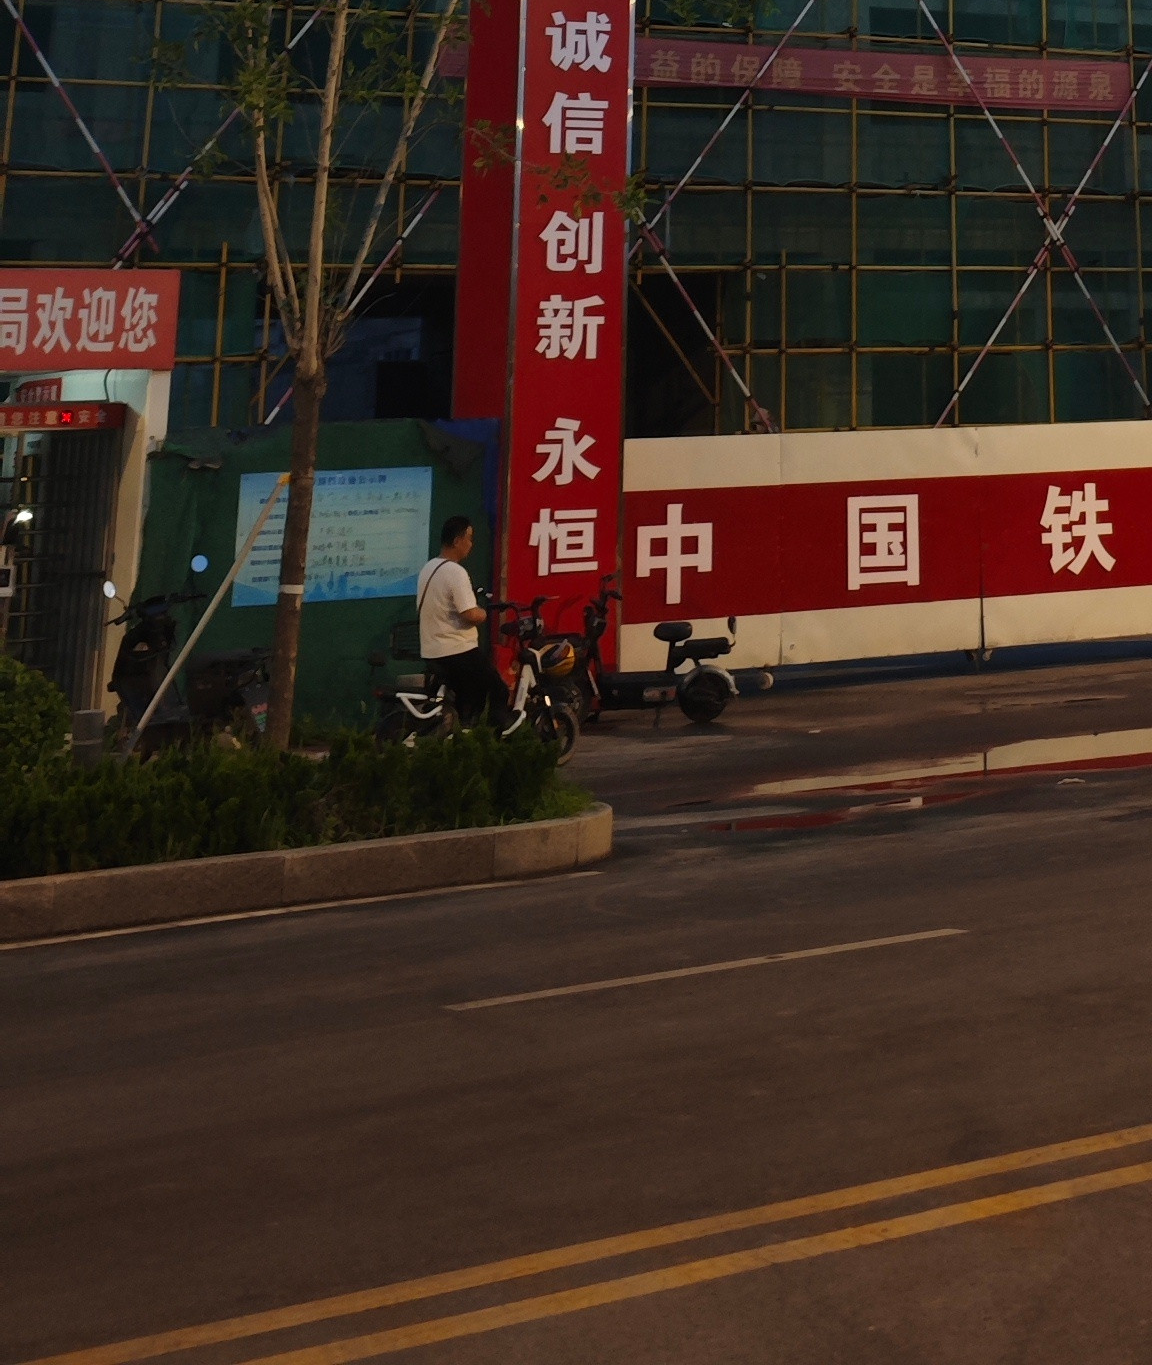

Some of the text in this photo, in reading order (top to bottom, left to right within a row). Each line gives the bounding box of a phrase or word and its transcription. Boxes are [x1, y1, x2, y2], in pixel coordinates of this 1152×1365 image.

[649, 49, 1116, 103] 益的保障 安全是幸福的源泉
[0, 286, 160, 356] 局欢迎您
[528, 10, 613, 578] 诚信 创新 永恒
